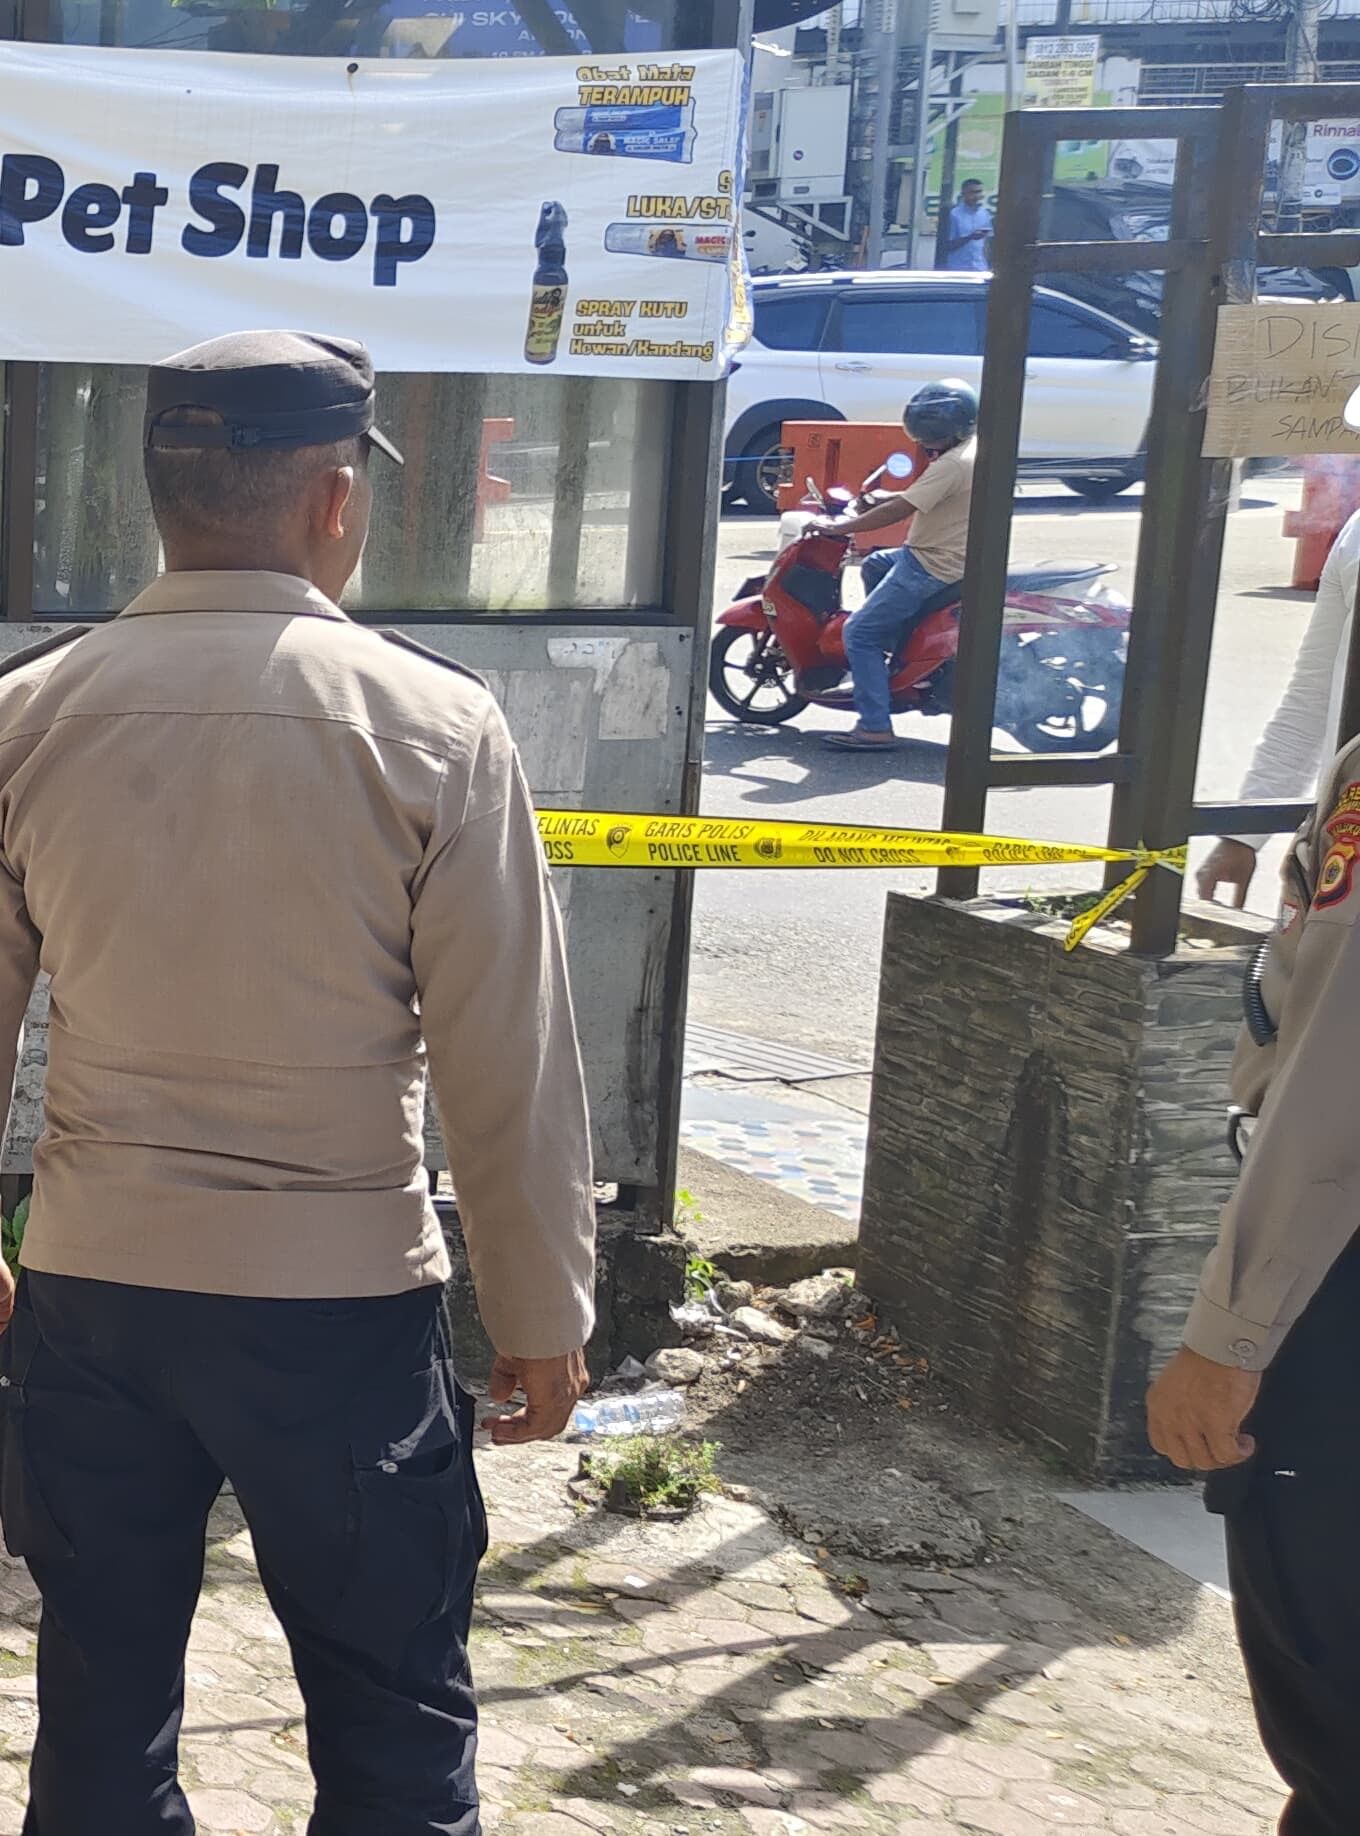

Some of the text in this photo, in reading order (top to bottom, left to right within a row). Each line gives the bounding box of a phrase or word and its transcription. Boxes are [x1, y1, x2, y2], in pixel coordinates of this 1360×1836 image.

[576, 63, 696, 82] Obat Mata
[578, 85, 691, 106] TERAMPUH
[627, 196, 732, 218] LUKA/ST
[180, 162, 436, 287] Shop
[576, 299, 636, 318] SPRAY
[639, 300, 688, 318] KUTU
[573, 320, 627, 337] untuk
[1259, 315, 1360, 359] DIS
[569, 338, 714, 362] Hewan/Kandang
[536, 816, 600, 836] ELINTAS
[644, 821, 757, 840] GARIS POLISI
[543, 840, 574, 860] OSS
[648, 842, 742, 863] POLICE LINE
[812, 847, 920, 864] DO NOT CROSS
